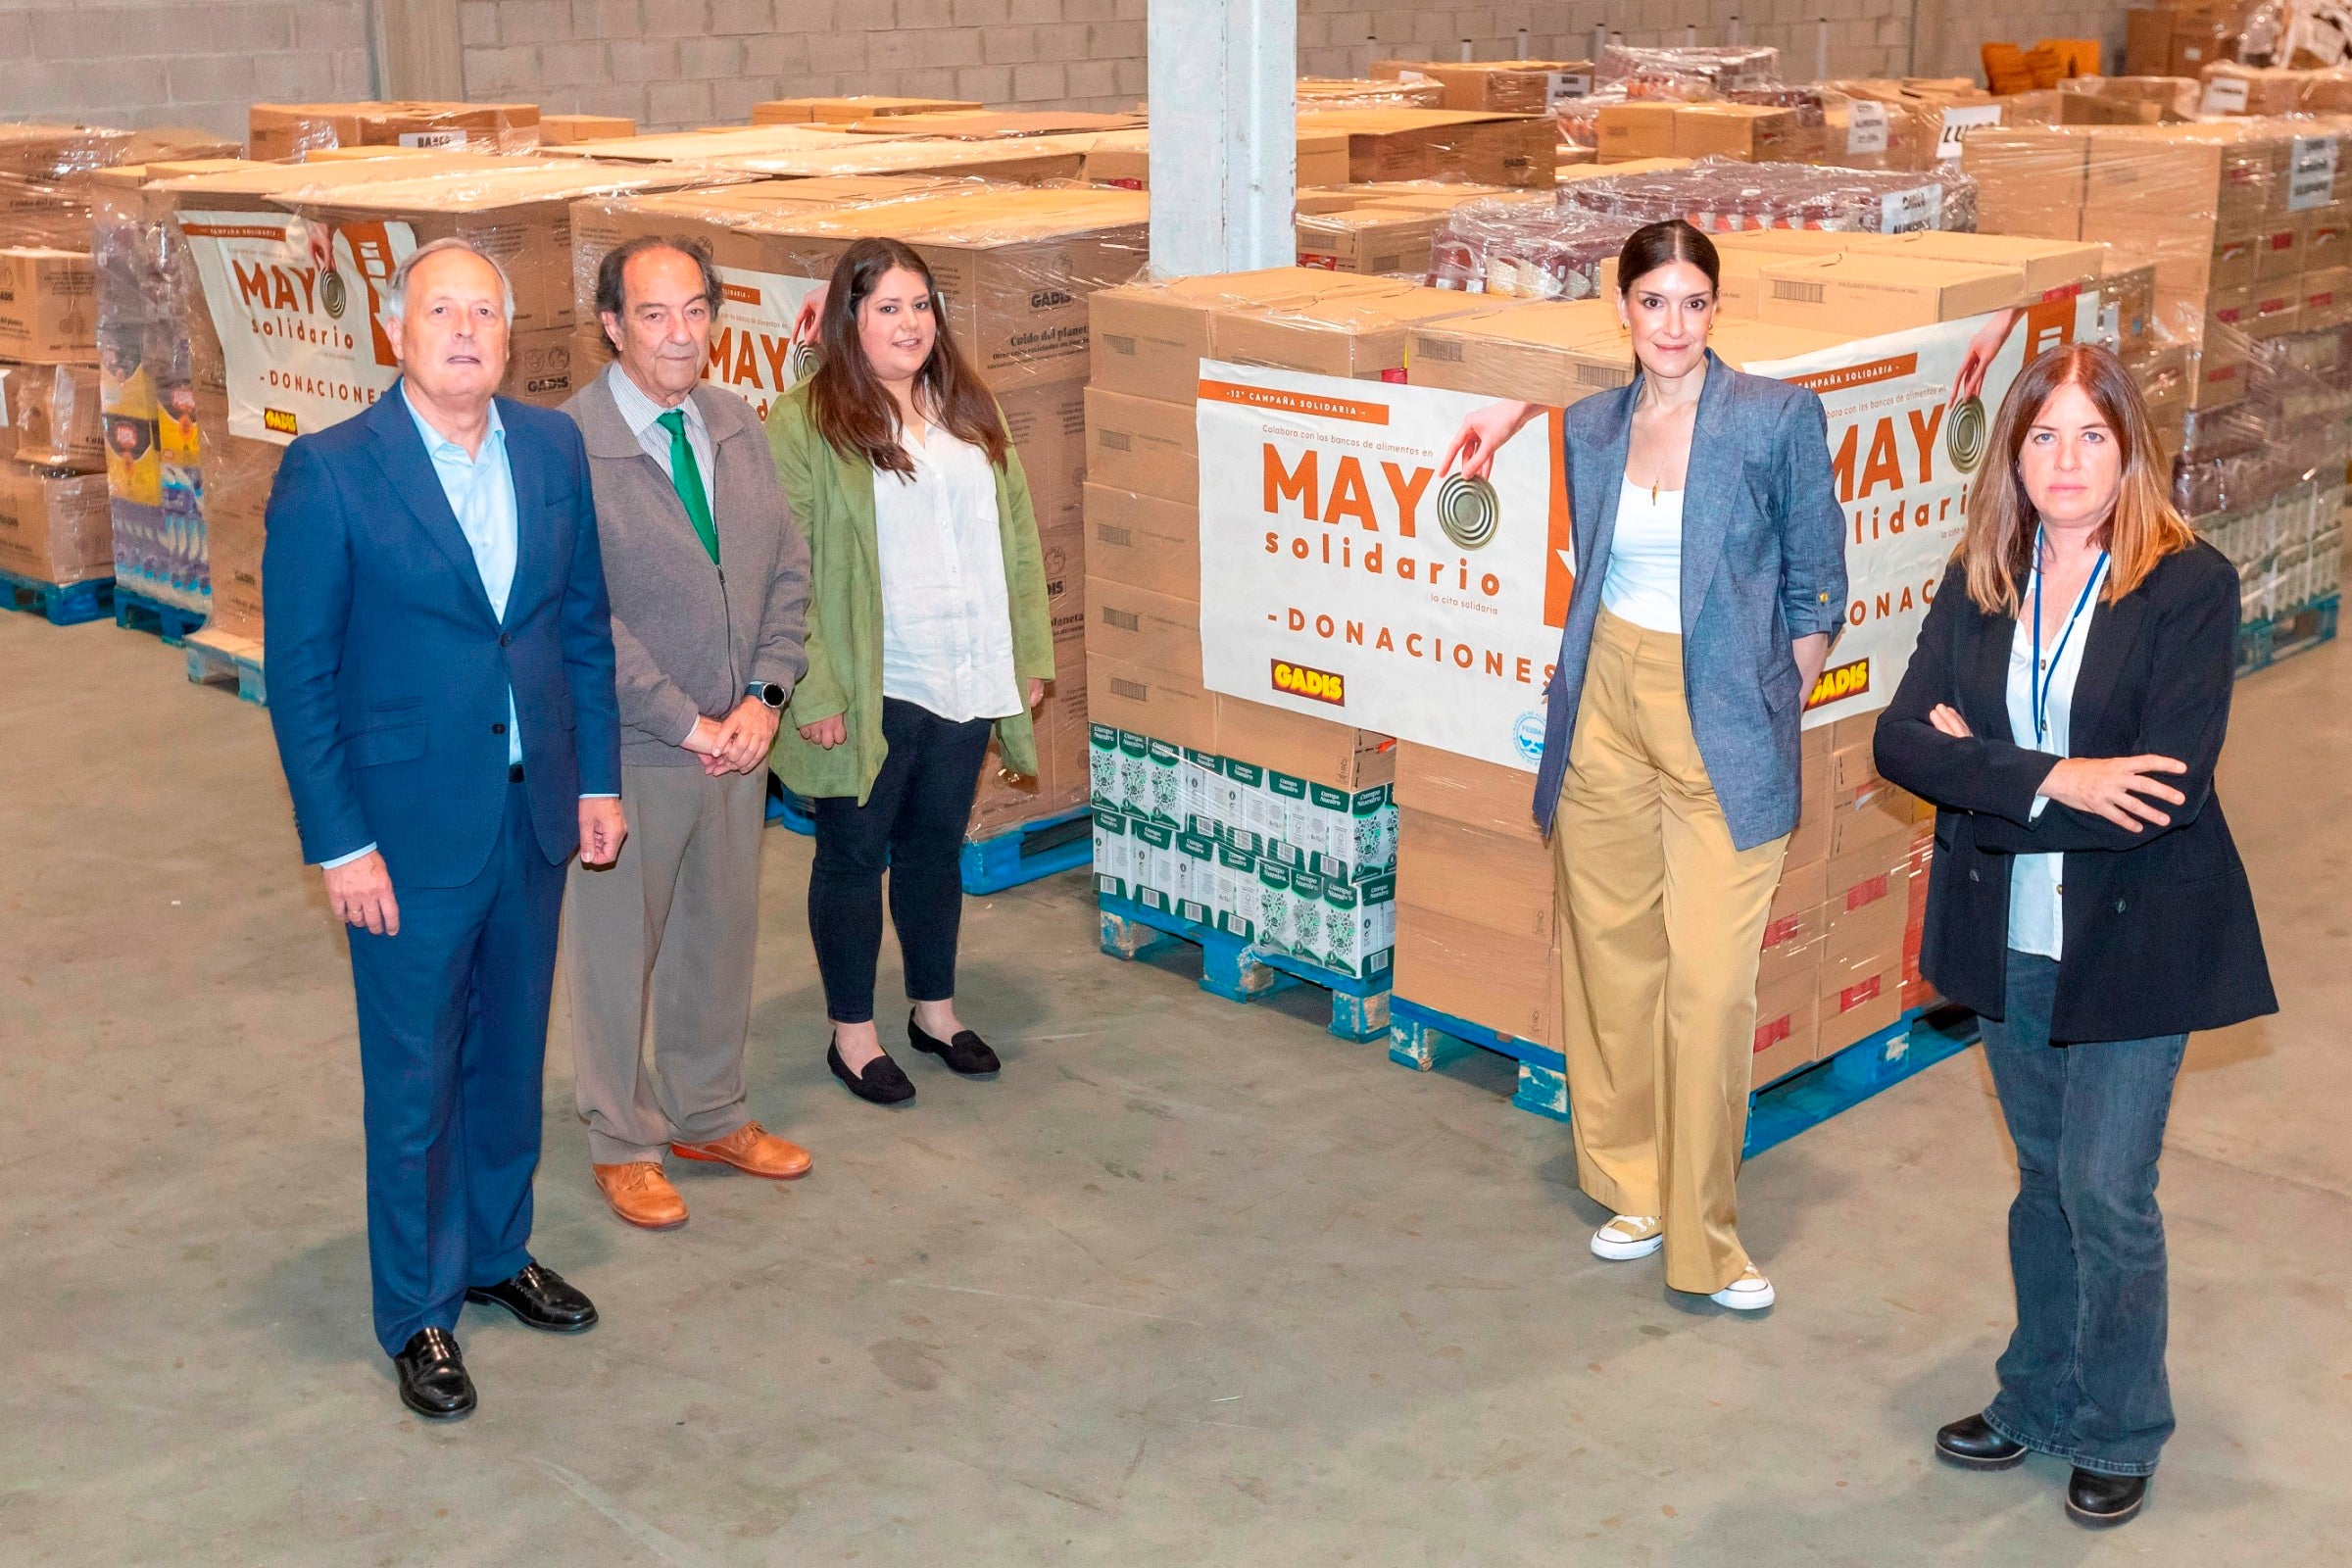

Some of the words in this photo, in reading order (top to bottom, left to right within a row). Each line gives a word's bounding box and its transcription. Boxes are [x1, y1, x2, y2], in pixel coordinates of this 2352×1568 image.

[1031, 292, 1072, 309] GADIS
[251, 316, 354, 350] solidario
[1010, 332, 1039, 347] Cuido
[1041, 328, 1055, 341] del
[1058, 325, 1090, 341] planet
[1844, 365, 1892, 382] SOLIDARIA
[527, 376, 569, 393] GADIS
[1249, 392, 1296, 407] CAMPAÑA
[1299, 400, 1356, 415] SOLIDARIA
[1870, 397, 1894, 410] bancos
[1896, 394, 1904, 403] de
[1906, 387, 1937, 400] alimentos
[265, 410, 297, 433] GADIS
[1262, 424, 1298, 437] Colabora
[1317, 432, 1329, 442] los
[1331, 434, 1360, 448] bancos
[1363, 438, 1374, 449] de
[1376, 442, 1419, 456] alimentos
[1422, 449, 1434, 458] en
[1855, 483, 1968, 545] lidari
[1264, 531, 1500, 597] solidario
[1431, 593, 1440, 604] la
[1442, 595, 1458, 606] cita
[1461, 598, 1498, 615] solidaria
[1273, 663, 1344, 701] GADIS
[1094, 724, 1114, 735] Campo
[1094, 731, 1114, 742] Nuestro
[1124, 732, 1144, 743] Campo
[1123, 738, 1145, 750] Nuestro
[1235, 764, 1252, 774] Campo
[1235, 769, 1253, 780] Nuestro
[1279, 778, 1298, 788] Campo
[1279, 783, 1298, 794] Nuestro
[1320, 791, 1340, 800] Campo
[1320, 796, 1341, 807] Nuestro
[1356, 795, 1381, 807] Nuestro
[1360, 789, 1381, 800] Campo
